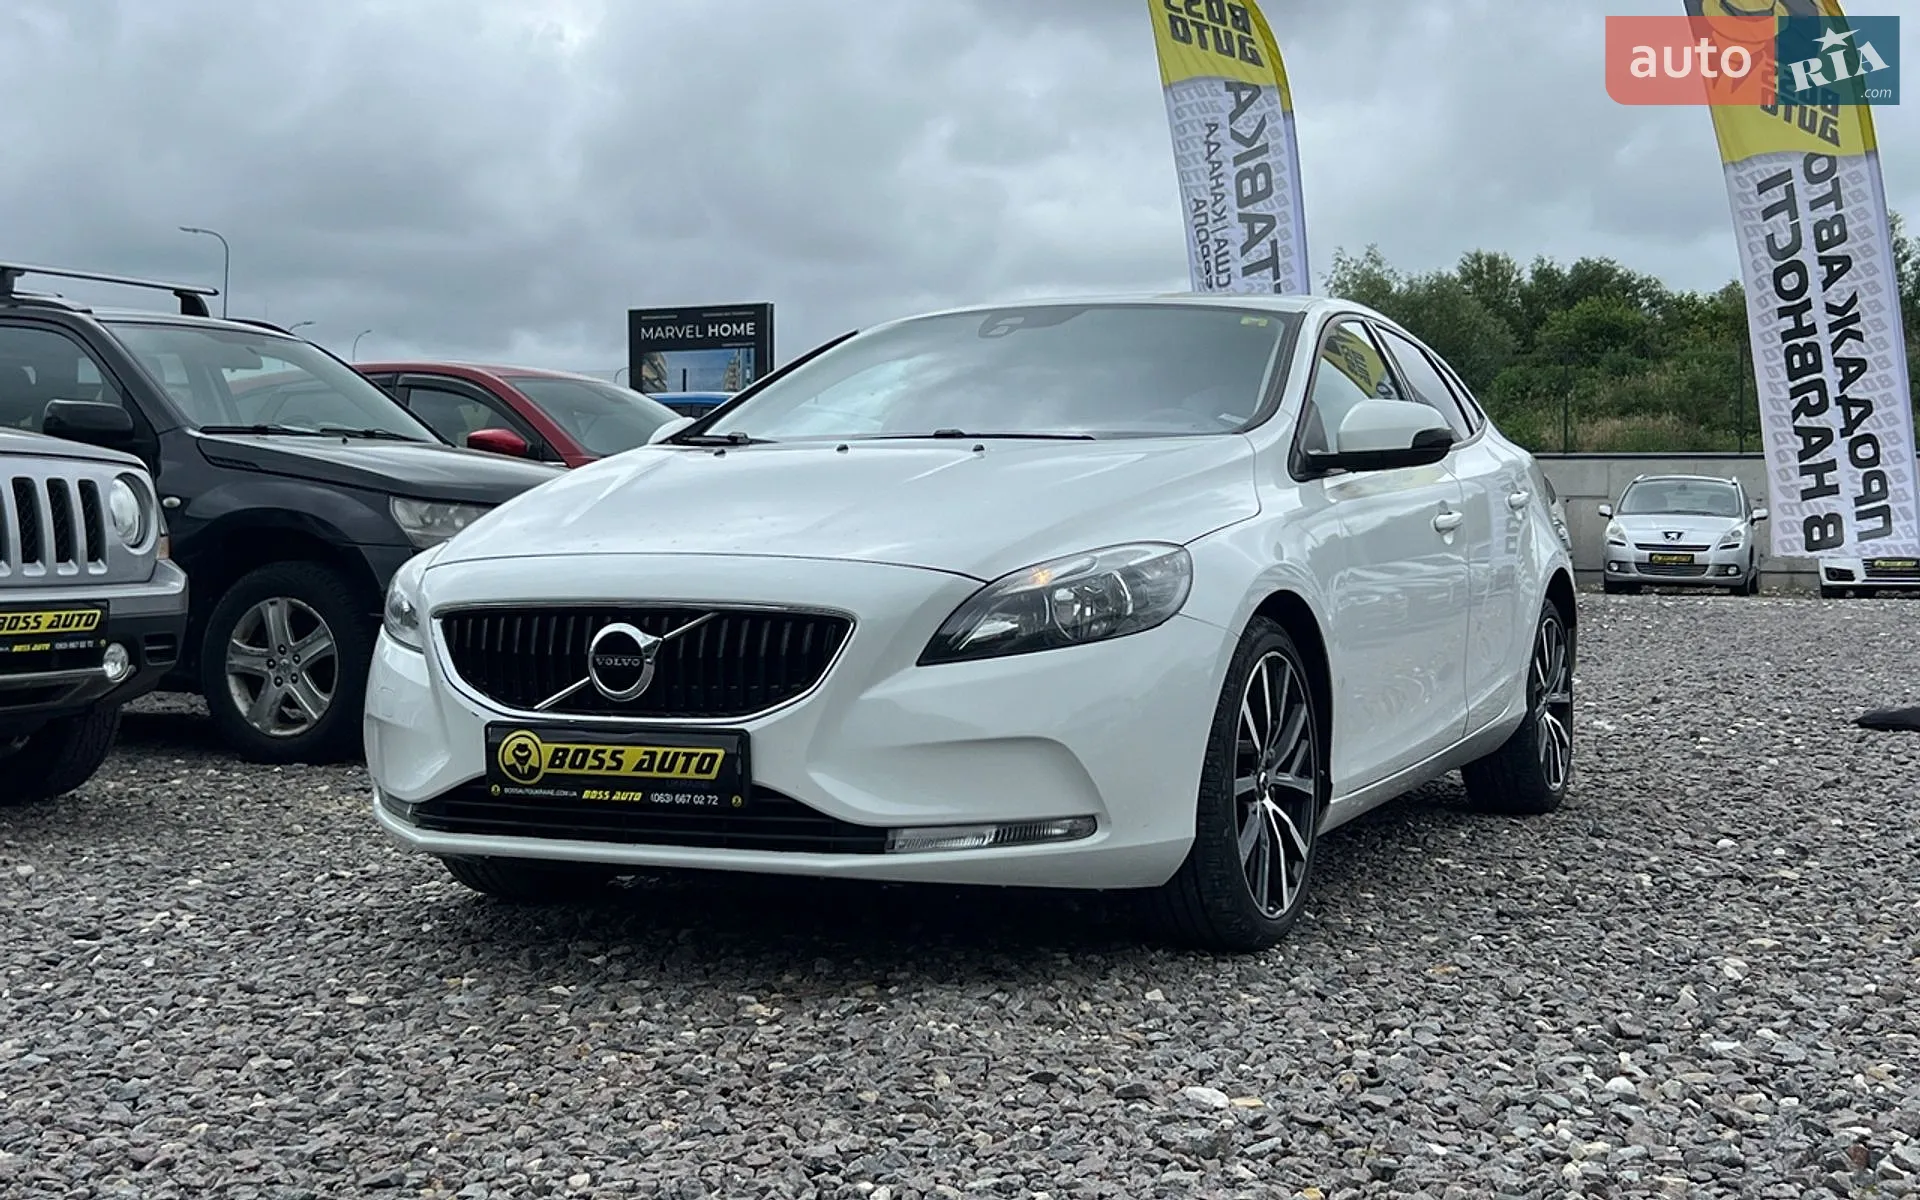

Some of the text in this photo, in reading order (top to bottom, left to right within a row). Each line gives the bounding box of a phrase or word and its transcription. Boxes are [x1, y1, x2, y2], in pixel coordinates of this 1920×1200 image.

[640, 322, 756, 340] MARVEL HOME
[47, 612, 98, 629] AUTO
[595, 657, 641, 667] VOLVO
[547, 747, 719, 775] BOSS AUTO
[582, 790, 643, 801] BOSS AUTO
[650, 792, 719, 806] (063) 667 02 72
